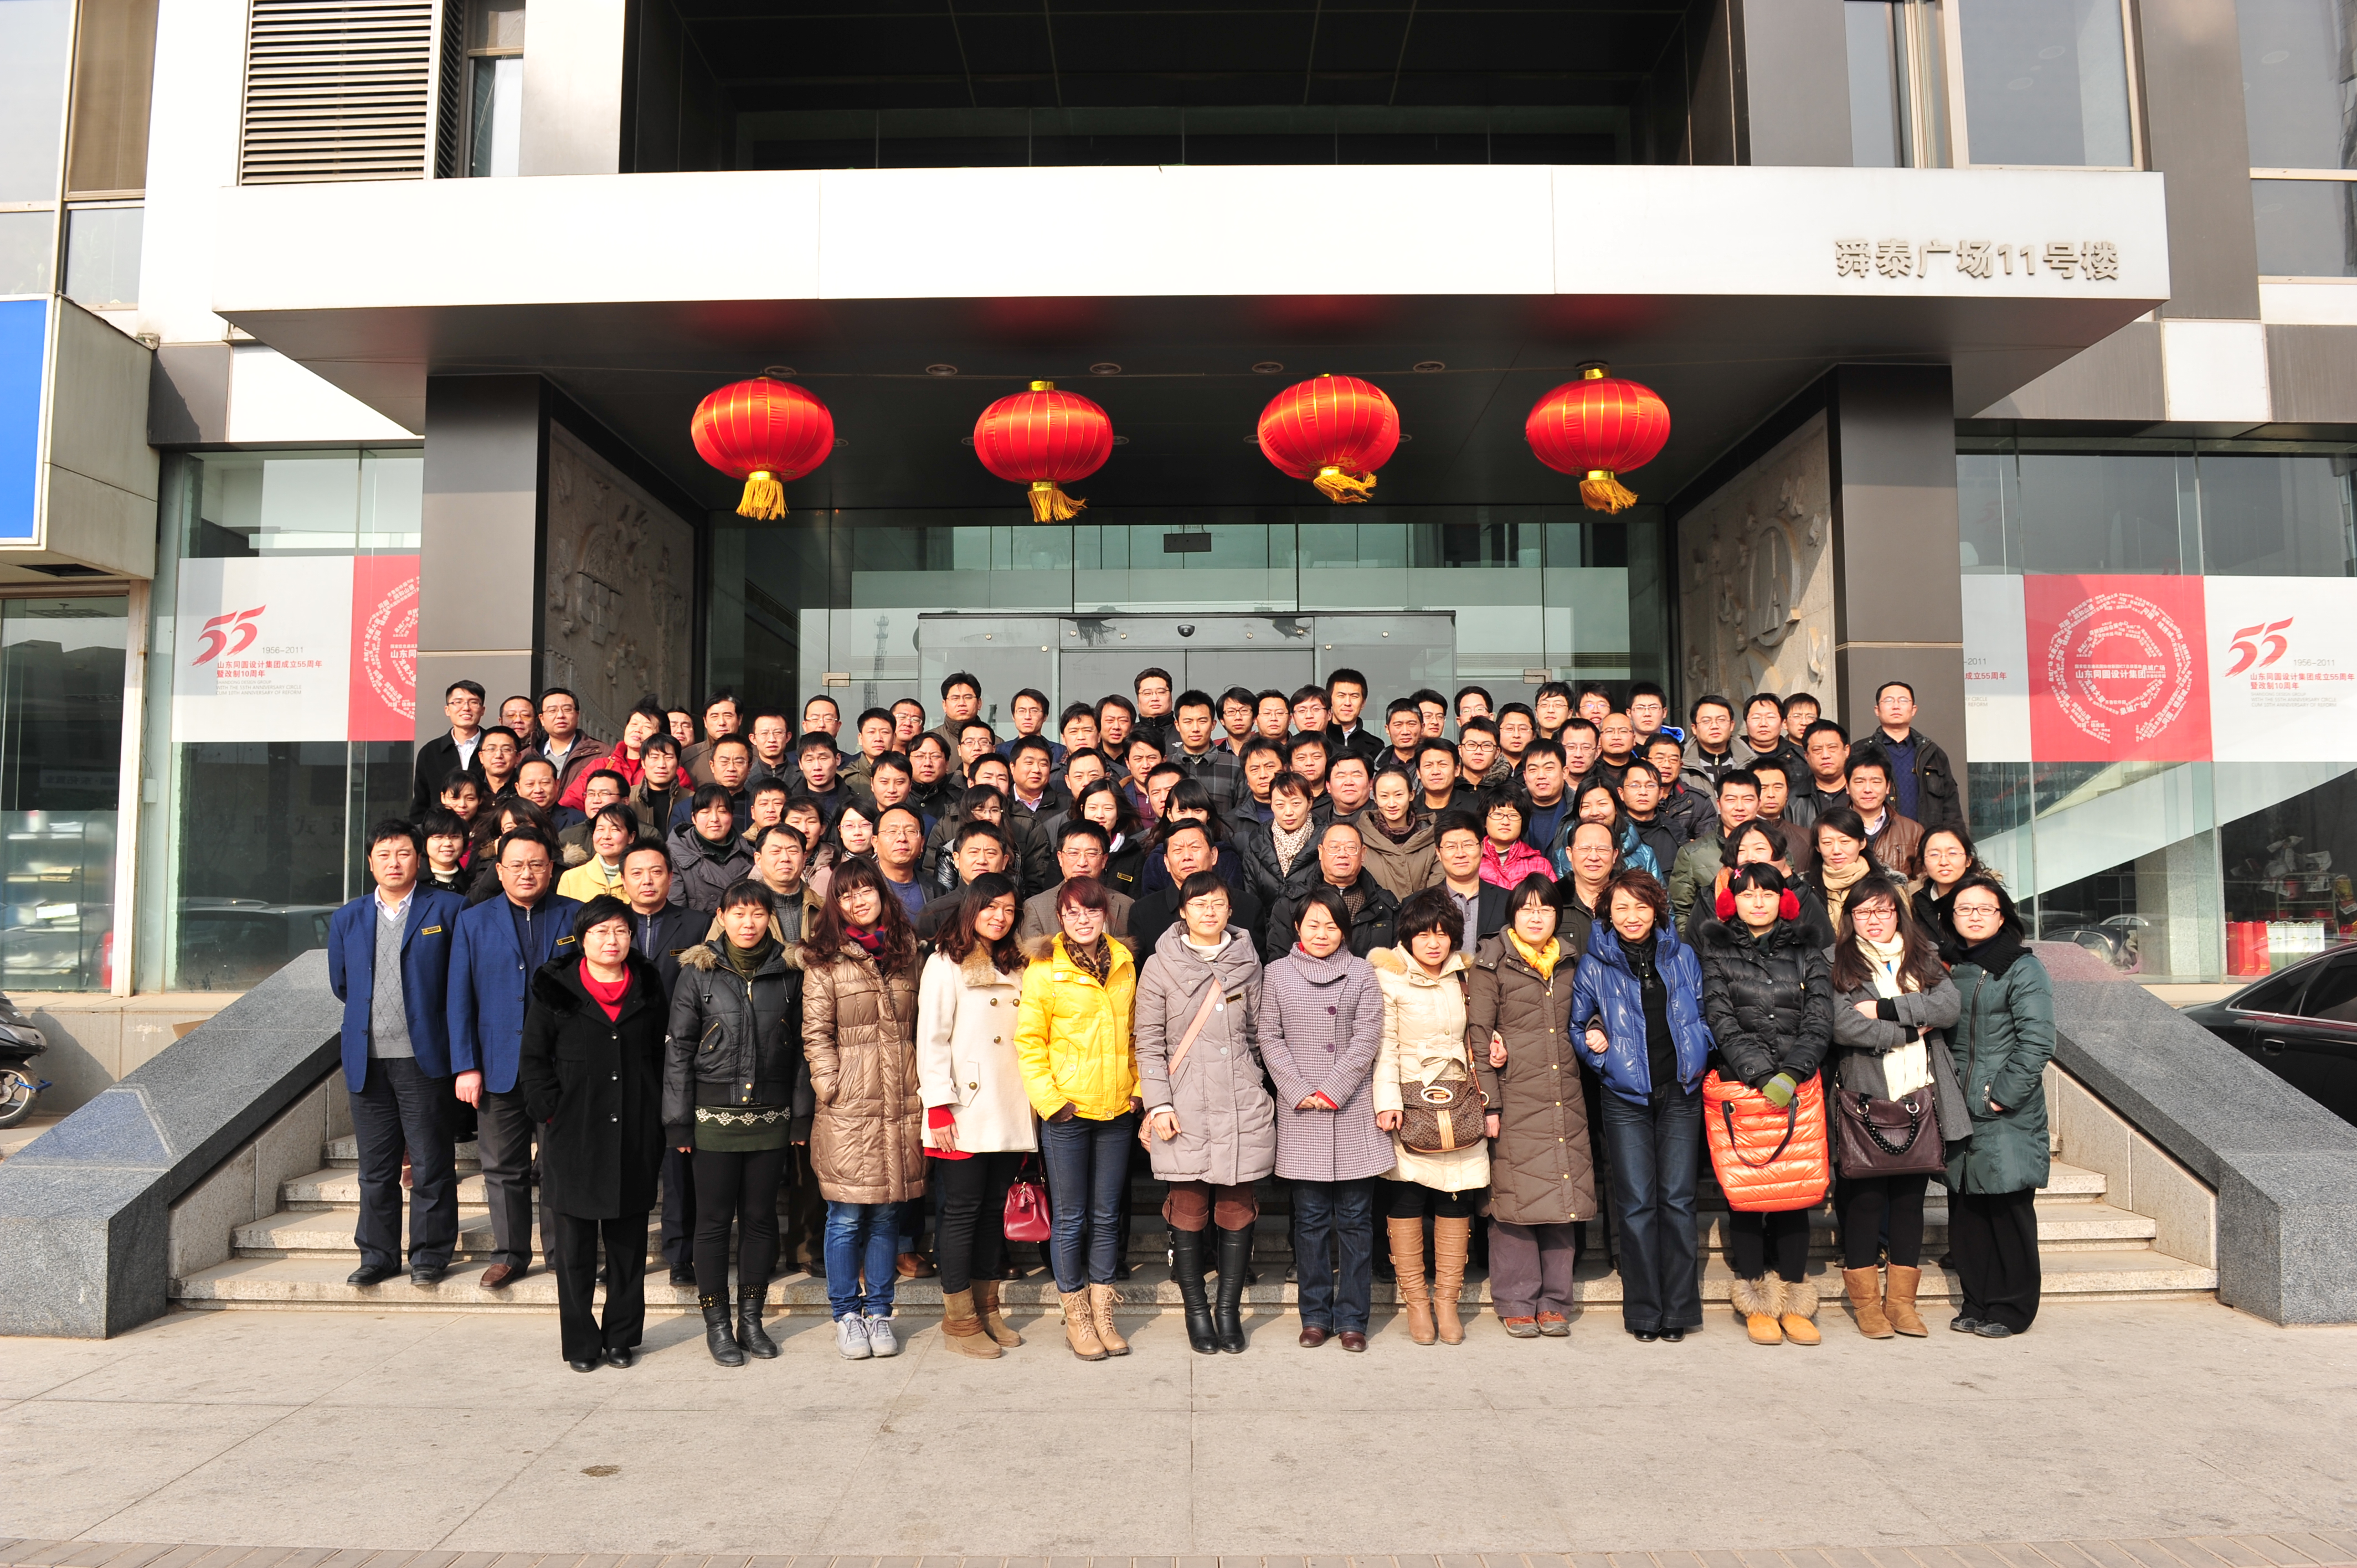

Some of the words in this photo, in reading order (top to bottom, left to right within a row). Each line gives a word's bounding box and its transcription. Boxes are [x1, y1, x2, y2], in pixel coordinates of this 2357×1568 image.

[1835, 239, 2119, 280] 舜泰广场11号楼
[188, 604, 267, 668] 55
[2221, 616, 2294, 678] 55
[1965, 672, 2007, 680] 成立55周年
